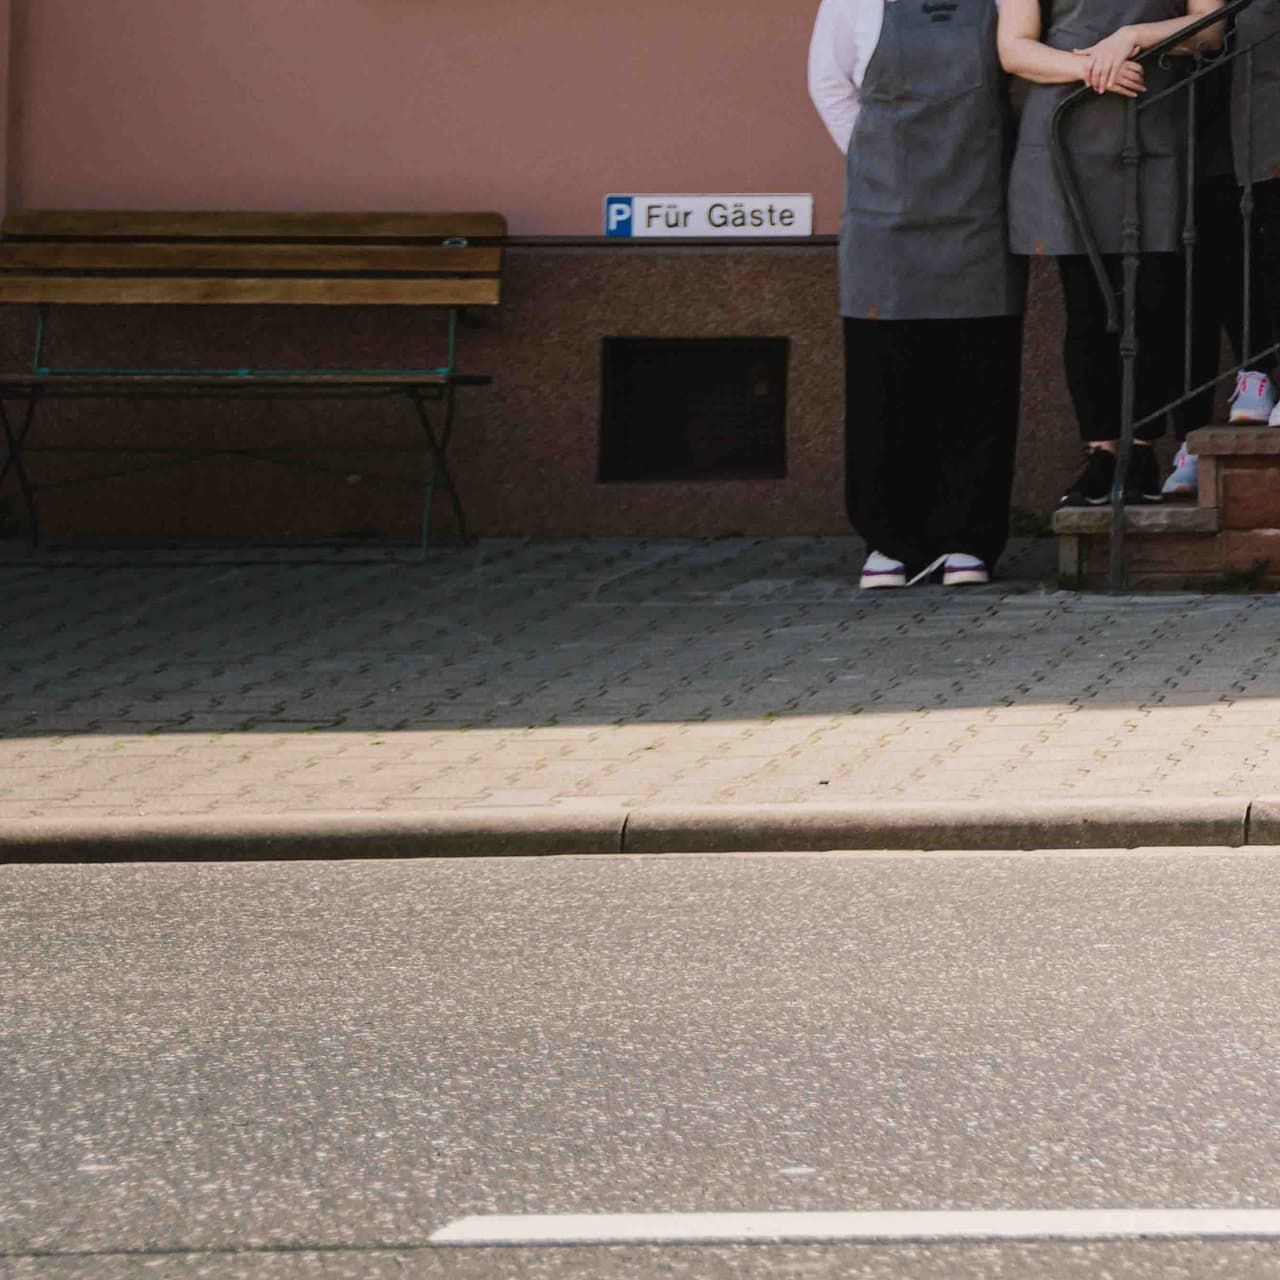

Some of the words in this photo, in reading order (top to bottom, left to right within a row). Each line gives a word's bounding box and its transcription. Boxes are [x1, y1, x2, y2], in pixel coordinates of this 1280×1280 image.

[608, 203, 632, 231] P
[646, 204, 693, 228] Für
[707, 203, 796, 228] Gäste
